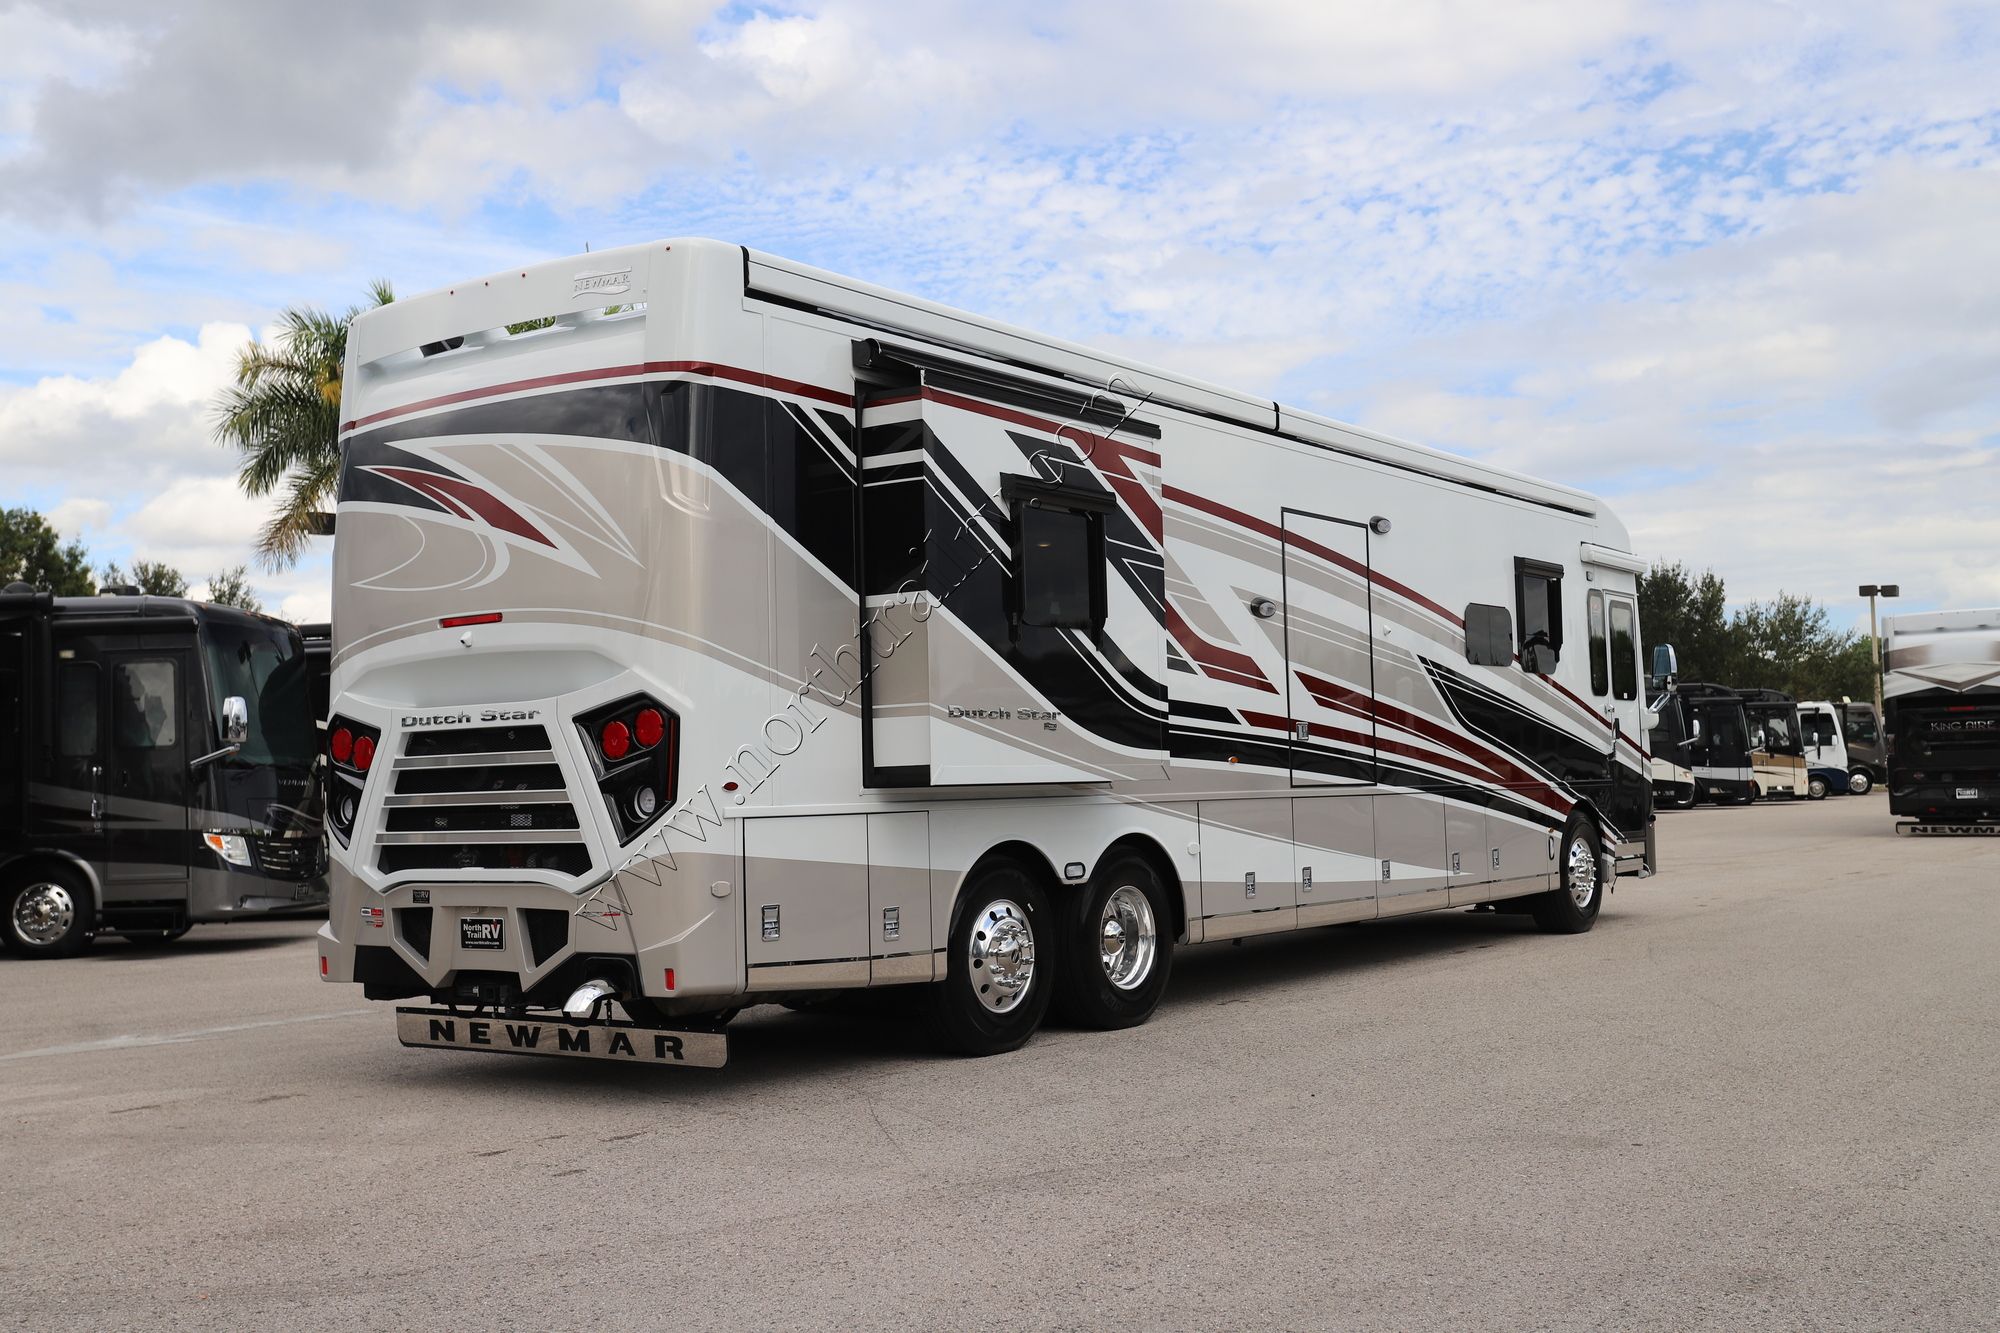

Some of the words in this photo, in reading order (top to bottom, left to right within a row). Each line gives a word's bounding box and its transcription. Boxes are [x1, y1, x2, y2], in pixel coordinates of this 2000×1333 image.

[574, 273, 630, 291] NEWMAR
[401, 710, 471, 727] Dutch
[480, 709, 541, 721] Star
[948, 705, 1011, 719] Dutch
[1017, 707, 1061, 720] Star
[1930, 722, 1962, 731] KING
[1965, 720, 1996, 730] AIRE
[463, 923, 481, 931] North
[482, 923, 500, 939] RV
[467, 931, 481, 939] Trail
[429, 1019, 684, 1060] NEWMAR
